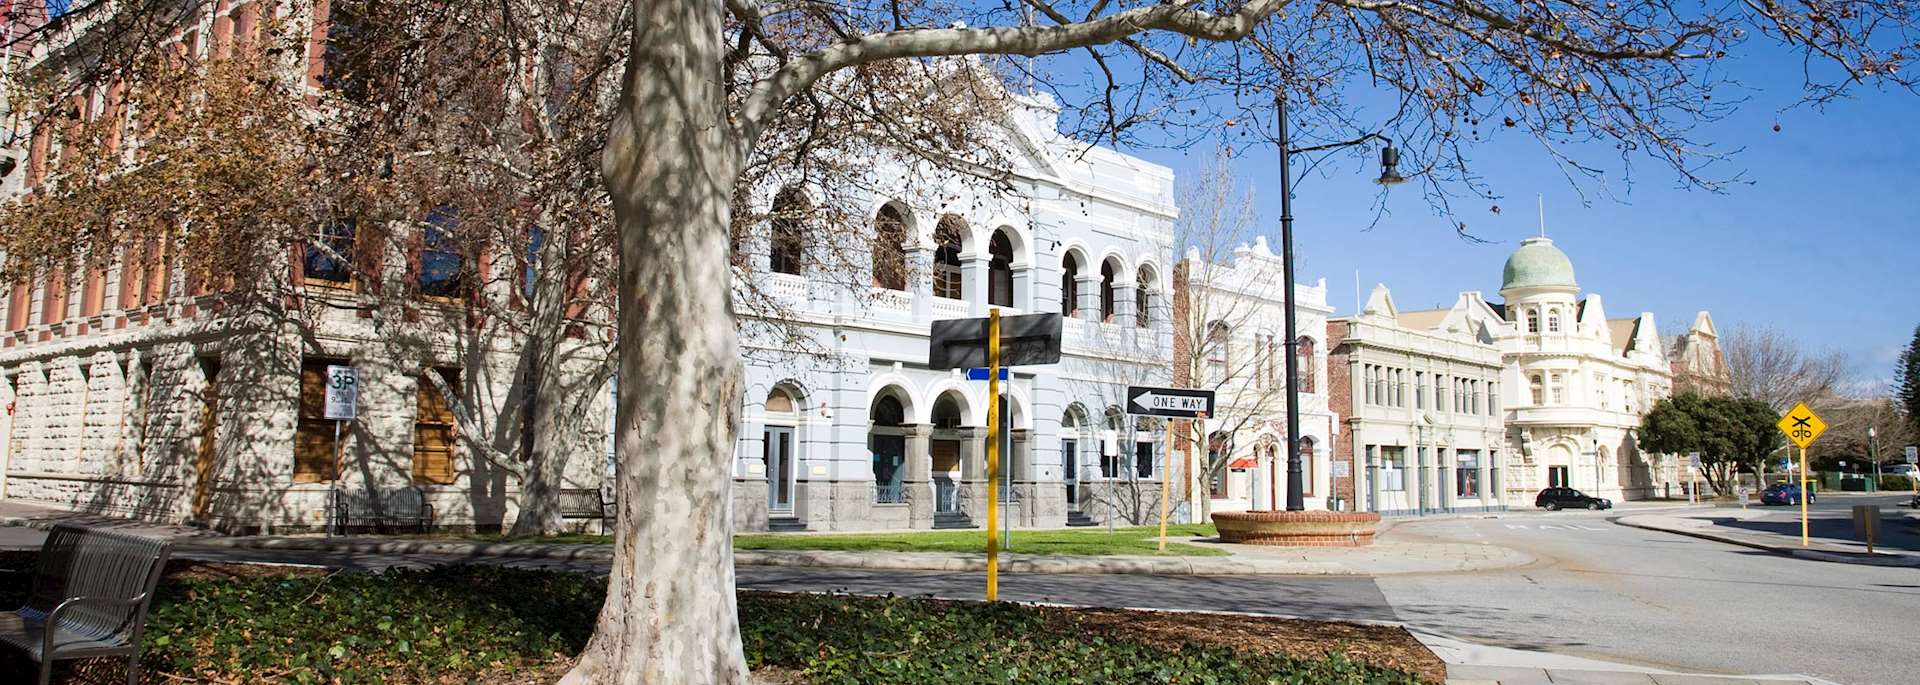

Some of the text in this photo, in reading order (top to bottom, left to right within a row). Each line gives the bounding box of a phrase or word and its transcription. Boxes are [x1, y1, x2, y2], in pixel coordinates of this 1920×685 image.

[331, 374, 354, 390] 3P
[1153, 396, 1202, 409] ONE WAY
